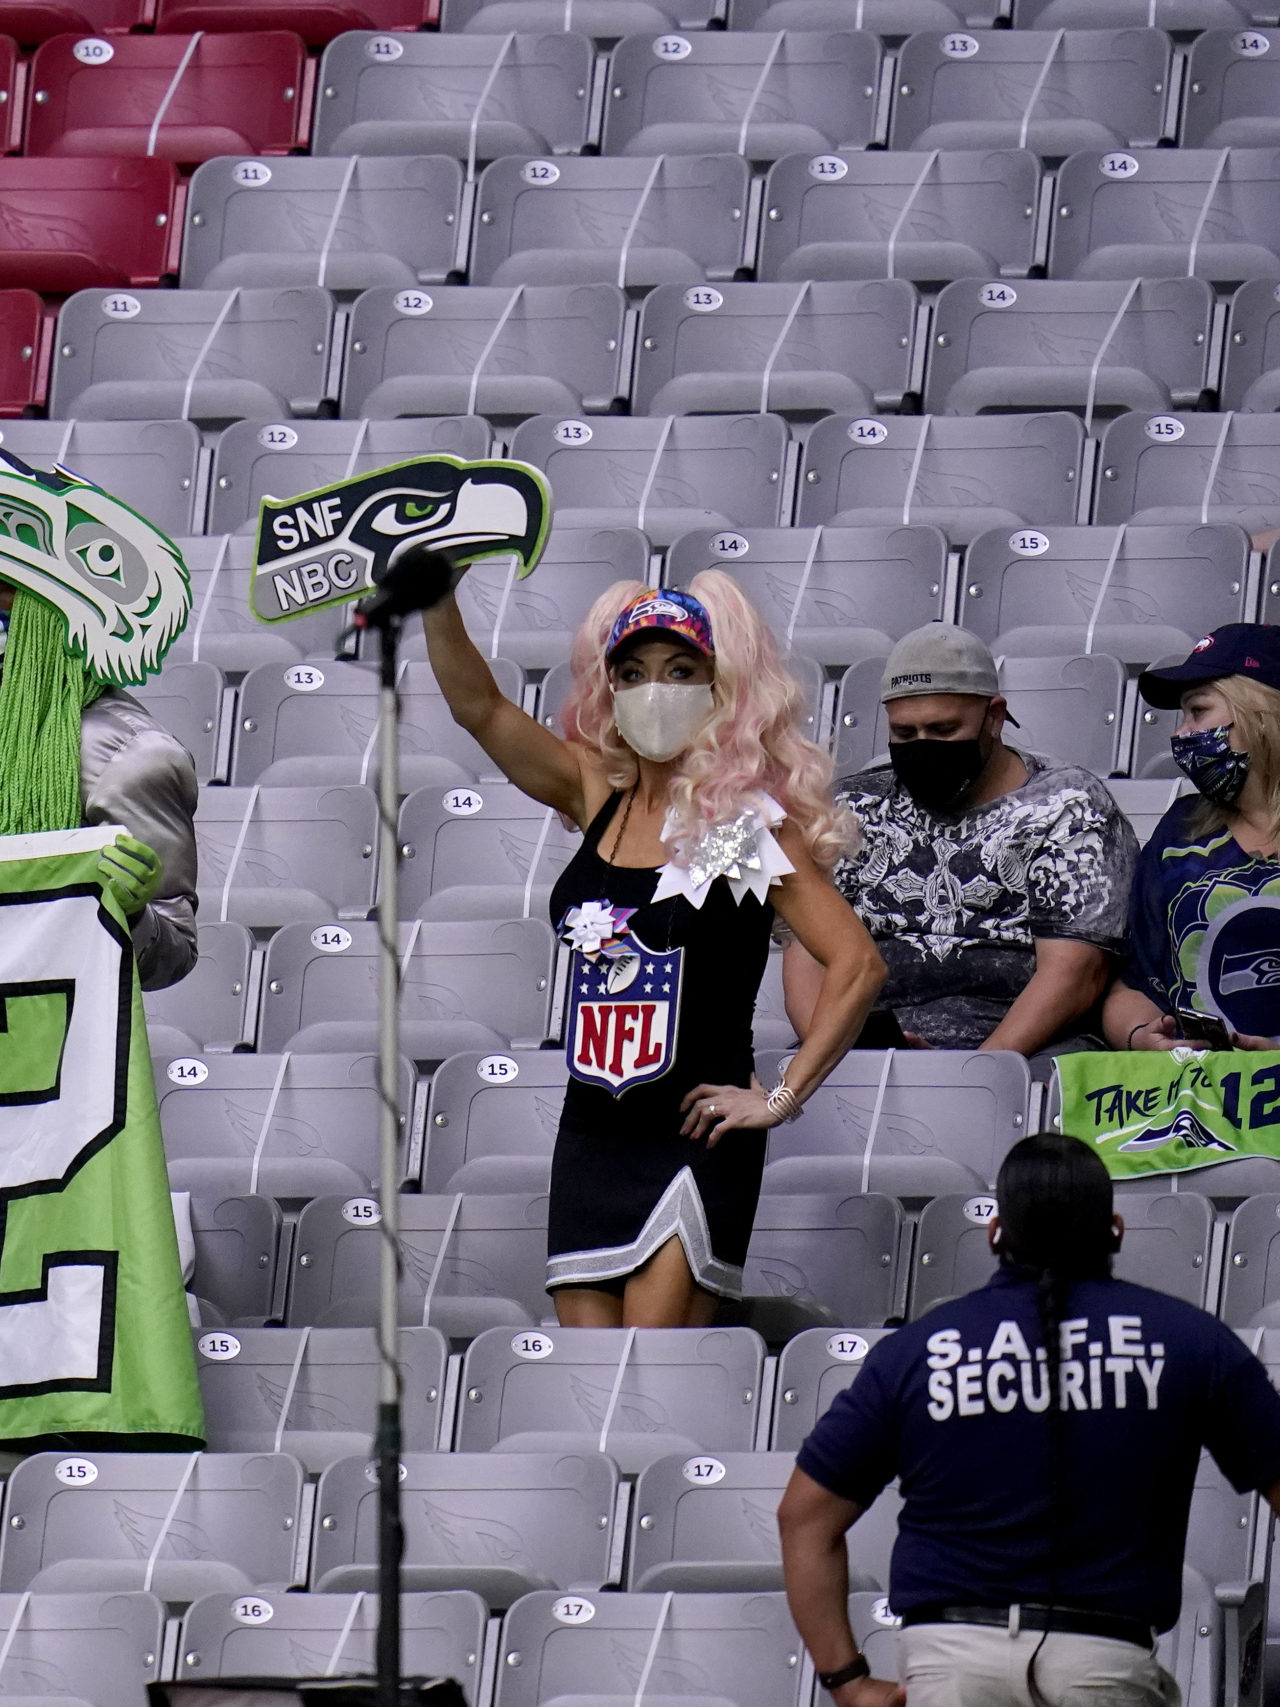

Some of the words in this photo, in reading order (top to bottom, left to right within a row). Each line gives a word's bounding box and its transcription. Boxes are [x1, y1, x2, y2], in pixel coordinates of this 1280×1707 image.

[374, 42, 392, 55] 11
[662, 41, 681, 54] 12
[949, 39, 969, 52] 13
[1240, 38, 1259, 50] 14
[84, 45, 103, 57] 10
[818, 162, 837, 174] 13
[1109, 159, 1128, 172] 14
[242, 168, 260, 180] 11
[530, 167, 549, 179] 12
[693, 293, 713, 305] 13
[987, 289, 1007, 301] 14
[112, 300, 130, 313] 11
[403, 296, 422, 309] 12
[563, 427, 582, 439] 13
[857, 426, 878, 438] 14
[1155, 422, 1175, 435] 15
[268, 431, 287, 443] 12
[272, 496, 343, 551] SNF
[718, 539, 739, 552] 14
[1019, 537, 1039, 550] 15
[272, 552, 359, 612] NBC
[294, 672, 314, 684] 13
[890, 672, 932, 689] PATRIOTS
[452, 796, 473, 808] 14
[321, 932, 342, 945] 14
[577, 1004, 663, 1079] NFL
[177, 1066, 198, 1078] 14
[488, 1063, 508, 1076] 15
[1084, 1084, 1163, 1130] TAKE
[1220, 1063, 1280, 1131] 12
[352, 1205, 373, 1218] 15
[974, 1204, 994, 1217] 17
[209, 1339, 230, 1353] 15
[522, 1339, 542, 1352] 16
[838, 1340, 857, 1353] 17
[926, 1315, 1166, 1370] S.A.F.E.
[926, 1356, 1166, 1422] SECURITY
[66, 1465, 87, 1478] 15
[694, 1464, 714, 1477] 17
[241, 1604, 262, 1617] 16
[564, 1603, 583, 1616] 17
